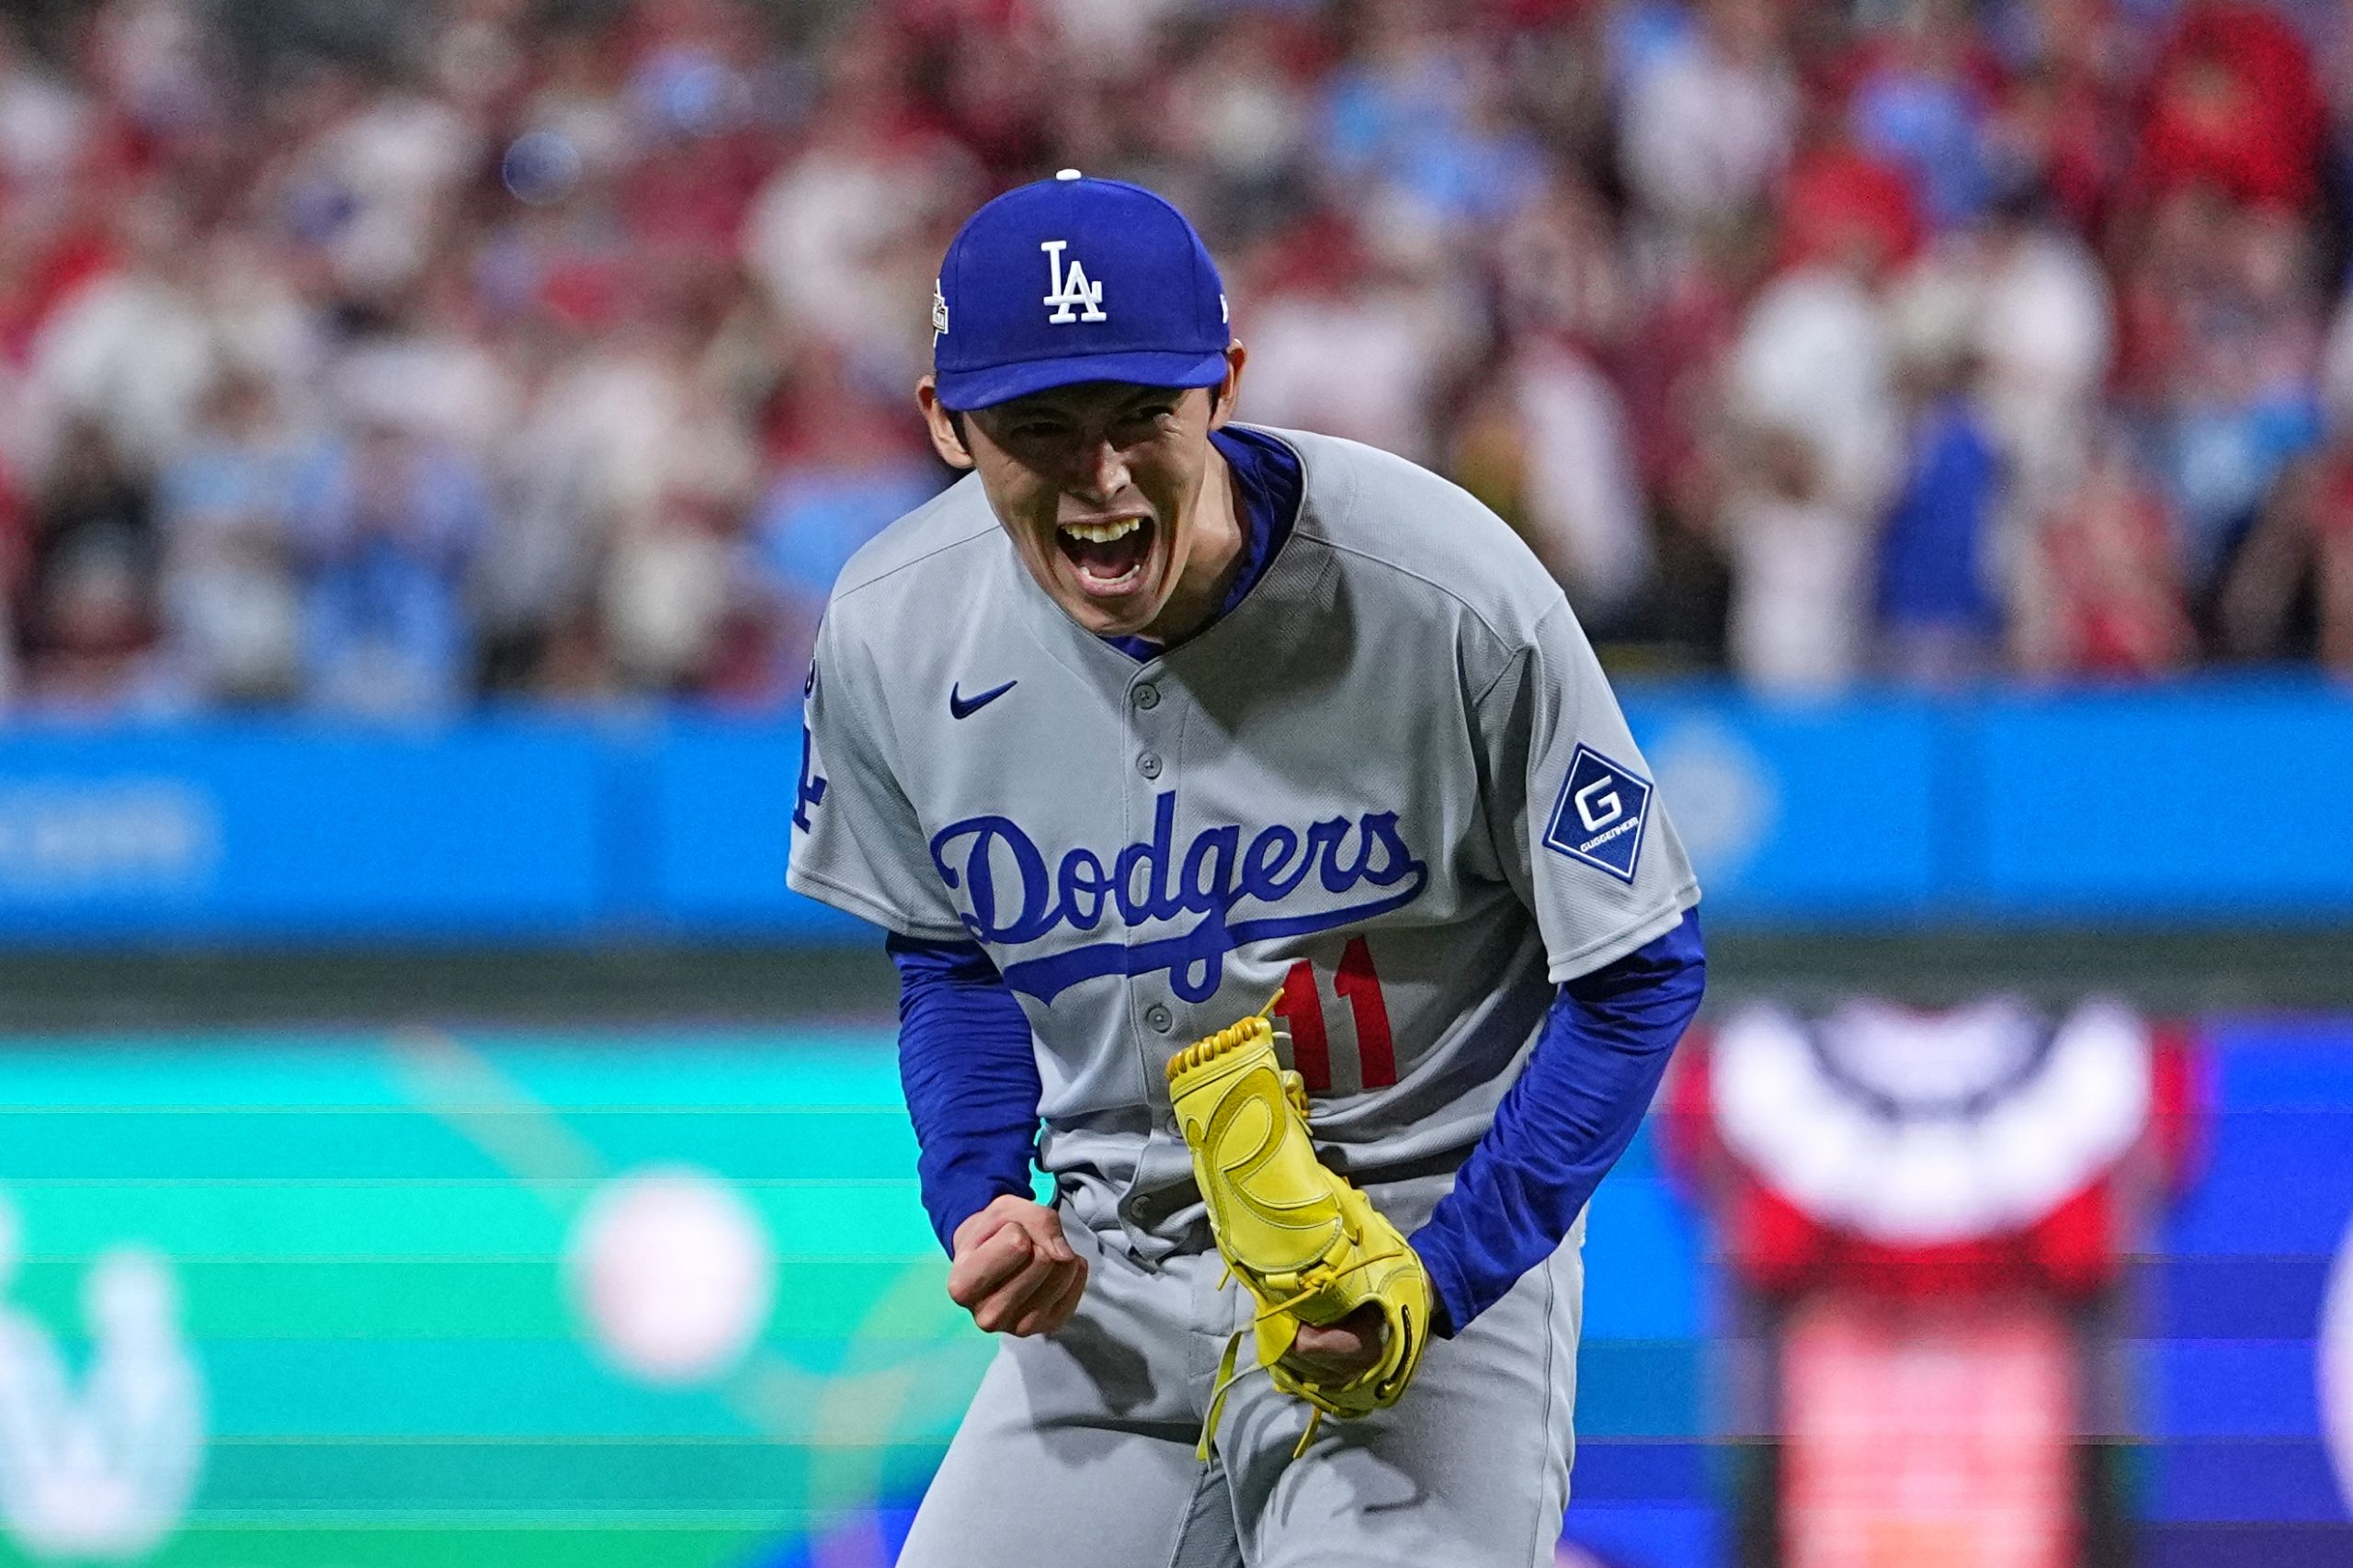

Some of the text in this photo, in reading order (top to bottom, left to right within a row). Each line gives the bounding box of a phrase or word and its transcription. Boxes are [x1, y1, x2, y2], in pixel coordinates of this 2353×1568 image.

[1041, 240, 1107, 324] LA
[1574, 775, 1622, 832] G
[1580, 816, 1639, 853] GUGGENHEIM
[930, 790, 1428, 1004] Dodgers
[1274, 935, 1396, 1090] 11
